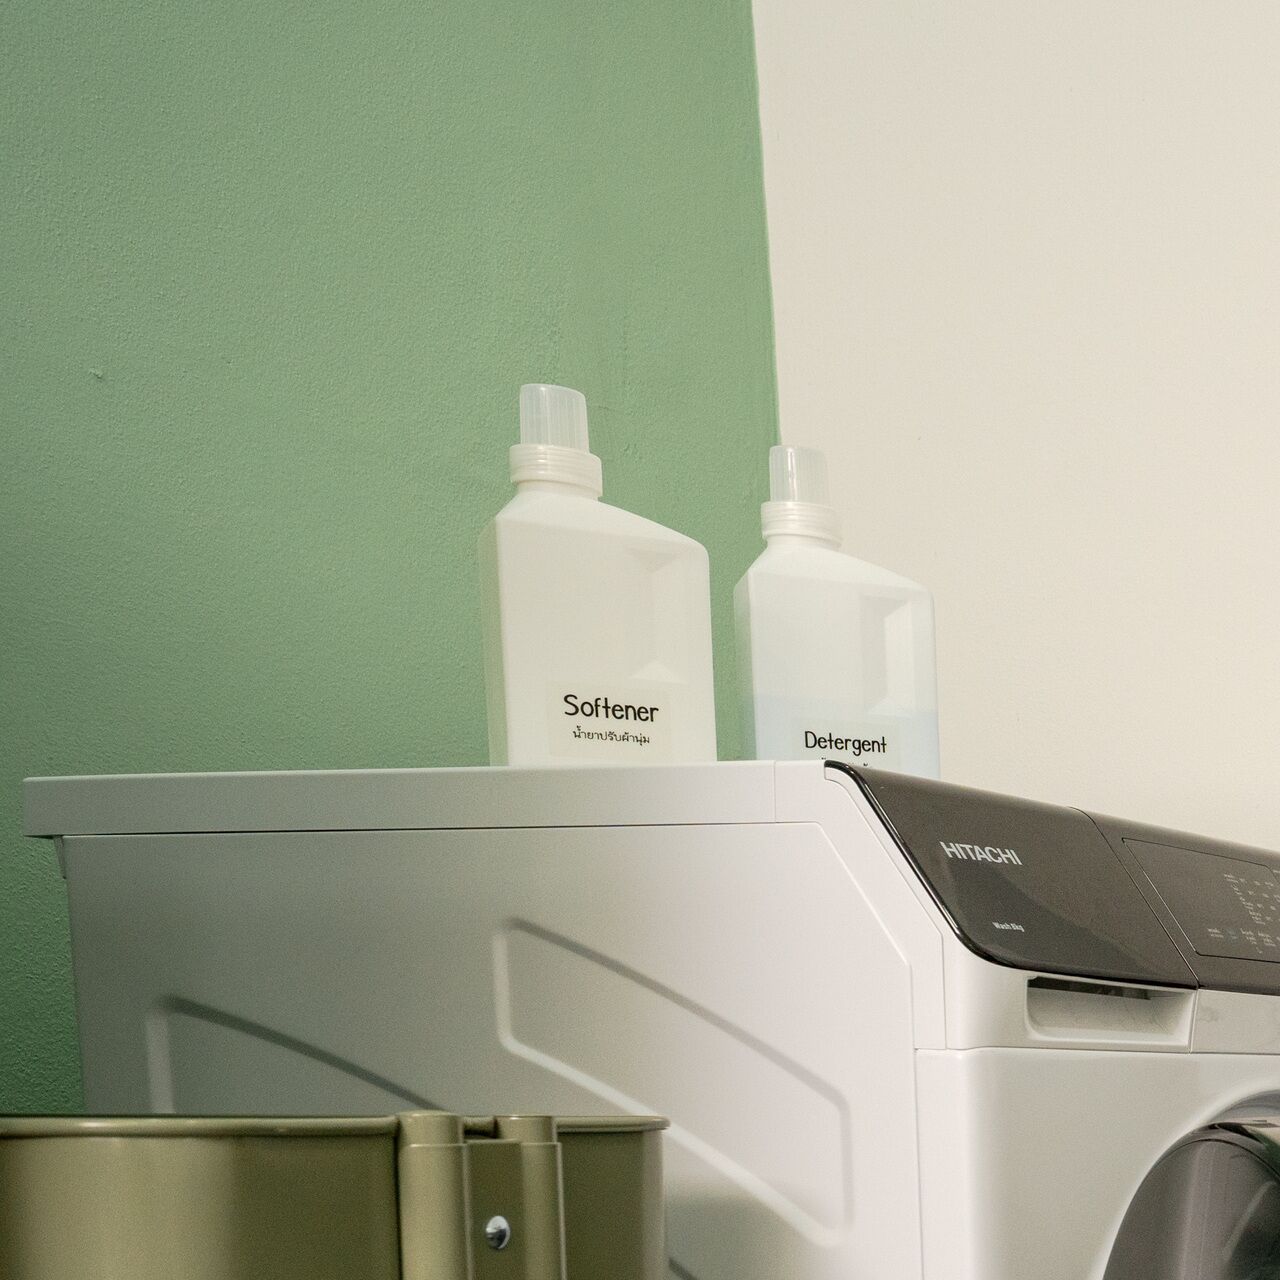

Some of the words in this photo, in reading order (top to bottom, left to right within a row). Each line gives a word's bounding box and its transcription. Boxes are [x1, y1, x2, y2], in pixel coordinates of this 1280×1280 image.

[563, 694, 659, 723] Softener
[572, 725, 650, 747] น้ำยาปรับผ้านุ่ม
[805, 731, 887, 757] Detergent
[939, 841, 1023, 866] HITACHI
